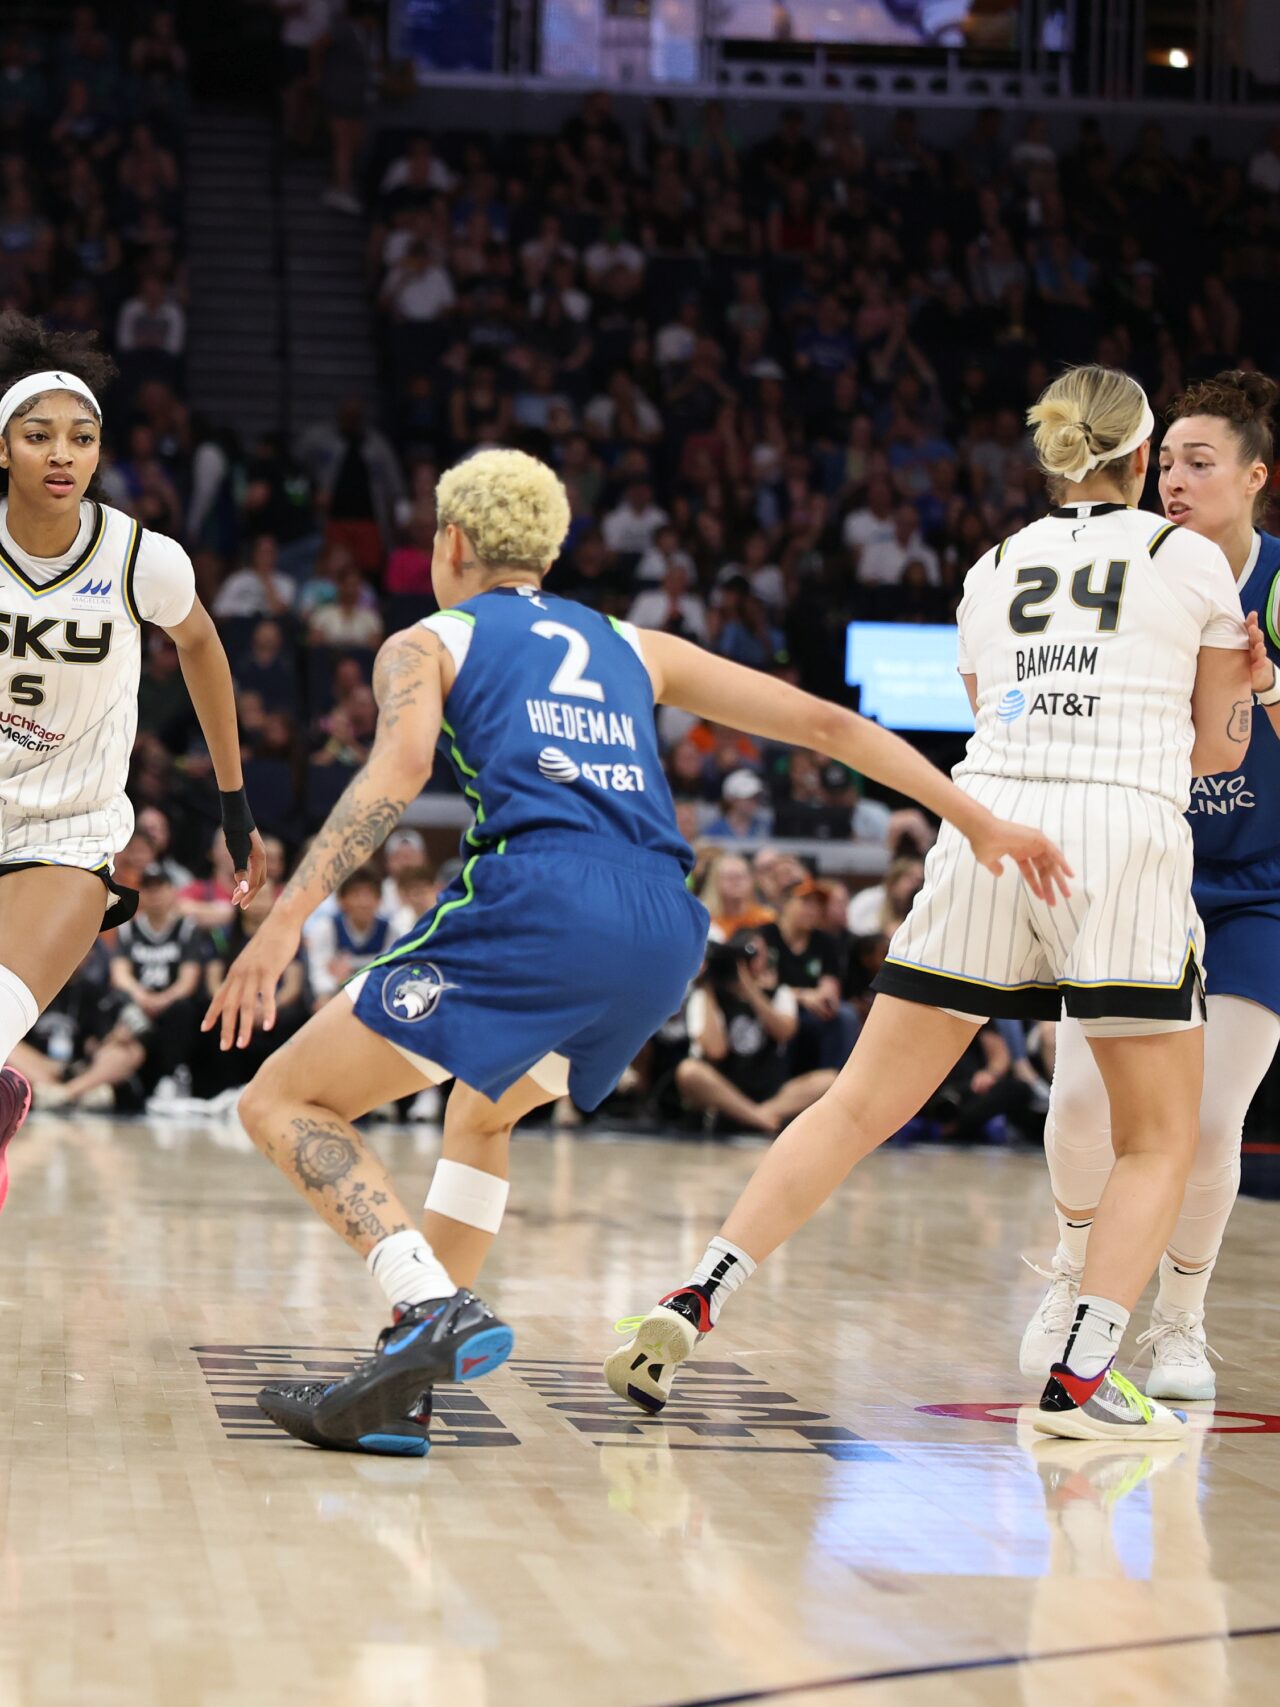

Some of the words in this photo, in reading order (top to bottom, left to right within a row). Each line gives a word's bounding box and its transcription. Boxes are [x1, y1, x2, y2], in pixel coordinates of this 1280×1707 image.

[1007, 559, 1130, 636] 24
[530, 620, 605, 702] 2
[1016, 644, 1098, 682] BANHAM
[9, 672, 46, 706] 5
[1029, 693, 1101, 718] AT&T
[0, 711, 65, 743] UChicago
[526, 700, 636, 751] HIEDEMAN
[581, 762, 645, 792] AT&T
[1191, 775, 1246, 796] AYO
